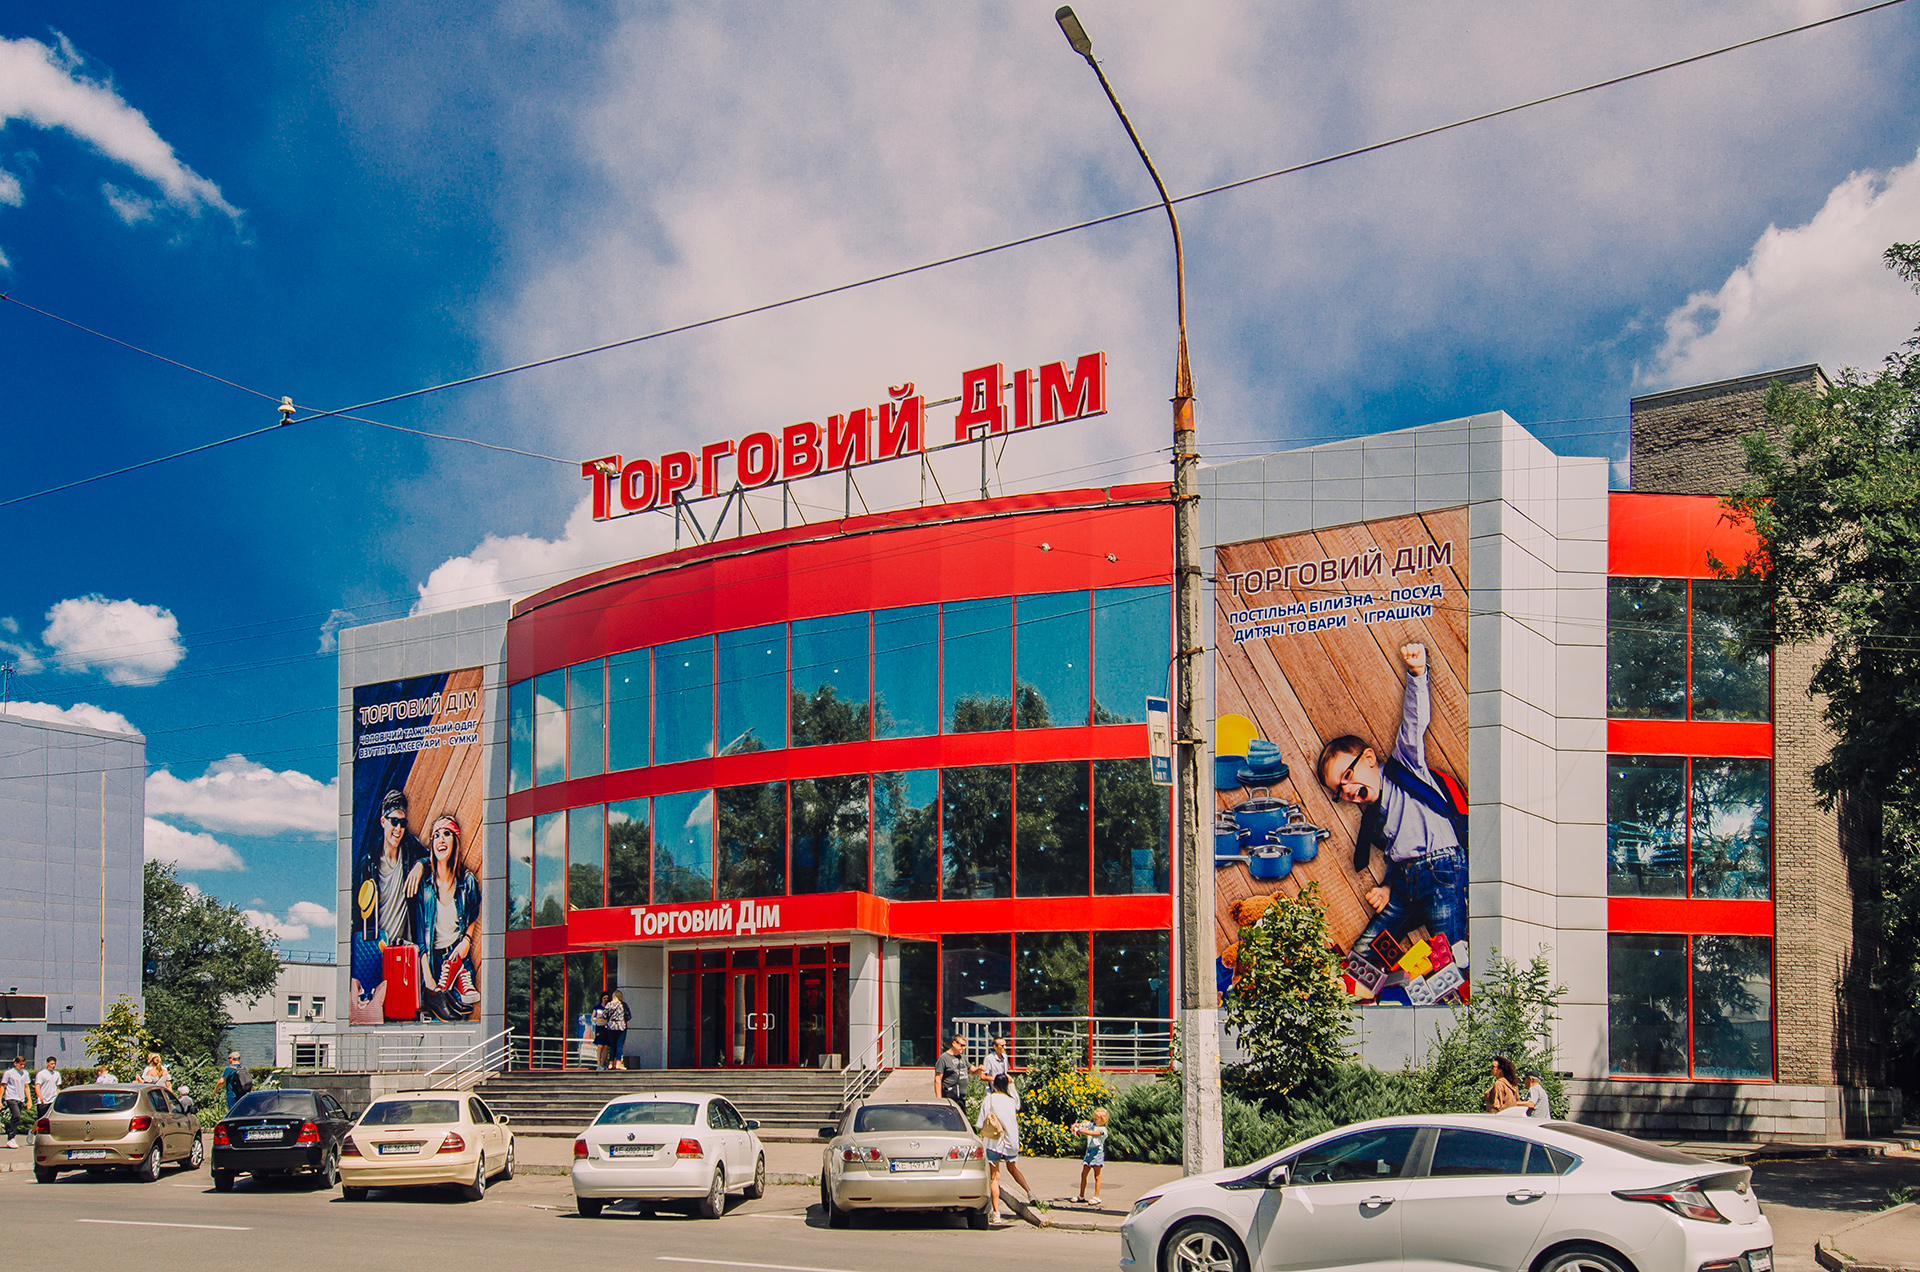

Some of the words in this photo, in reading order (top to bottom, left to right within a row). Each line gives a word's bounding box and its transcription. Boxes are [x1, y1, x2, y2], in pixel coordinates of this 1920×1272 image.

[1227, 548, 1383, 597] ТОРГОВИЙ
[1391, 541, 1453, 577] ДІМ
[1229, 603, 1306, 625] ПОСТІЛЬНА
[1309, 594, 1374, 613] БІЛИЗНА
[1390, 584, 1443, 602] ПОСУД
[1234, 622, 1285, 643] ДИТЯЧІ
[1288, 615, 1347, 634] ТОВАРИ
[1363, 605, 1433, 624] ІГРАШКИ
[359, 692, 443, 726] ТОРГОВИЙ
[445, 690, 478, 716] ДІМ
[454, 720, 478, 732] ОДЯГ
[449, 733, 478, 746] СУМКИ
